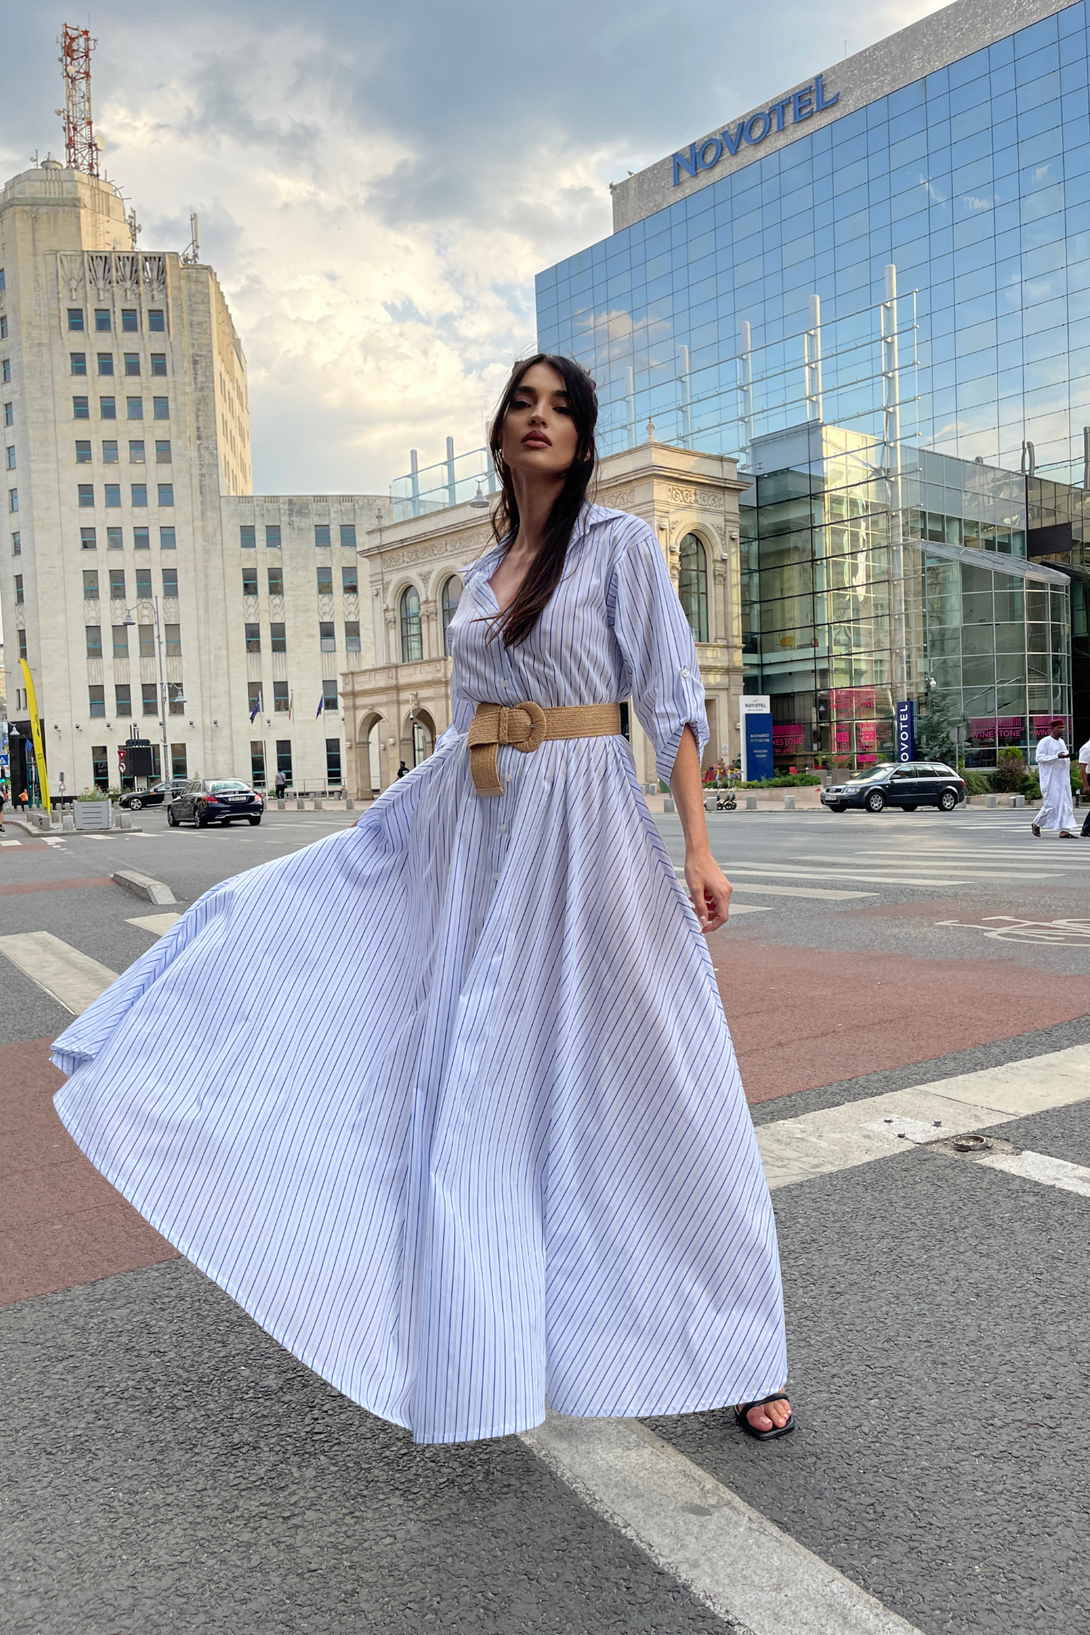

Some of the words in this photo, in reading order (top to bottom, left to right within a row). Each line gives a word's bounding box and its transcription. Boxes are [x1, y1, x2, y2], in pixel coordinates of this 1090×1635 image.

[672, 74, 840, 187] NOVOTEL
[830, 700, 875, 710] WINESTONE
[838, 733, 848, 741] 35
[900, 704, 909, 762] OVOTEL
[971, 729, 1021, 738] WINESTONE
[772, 737, 803, 746] NESTONE
